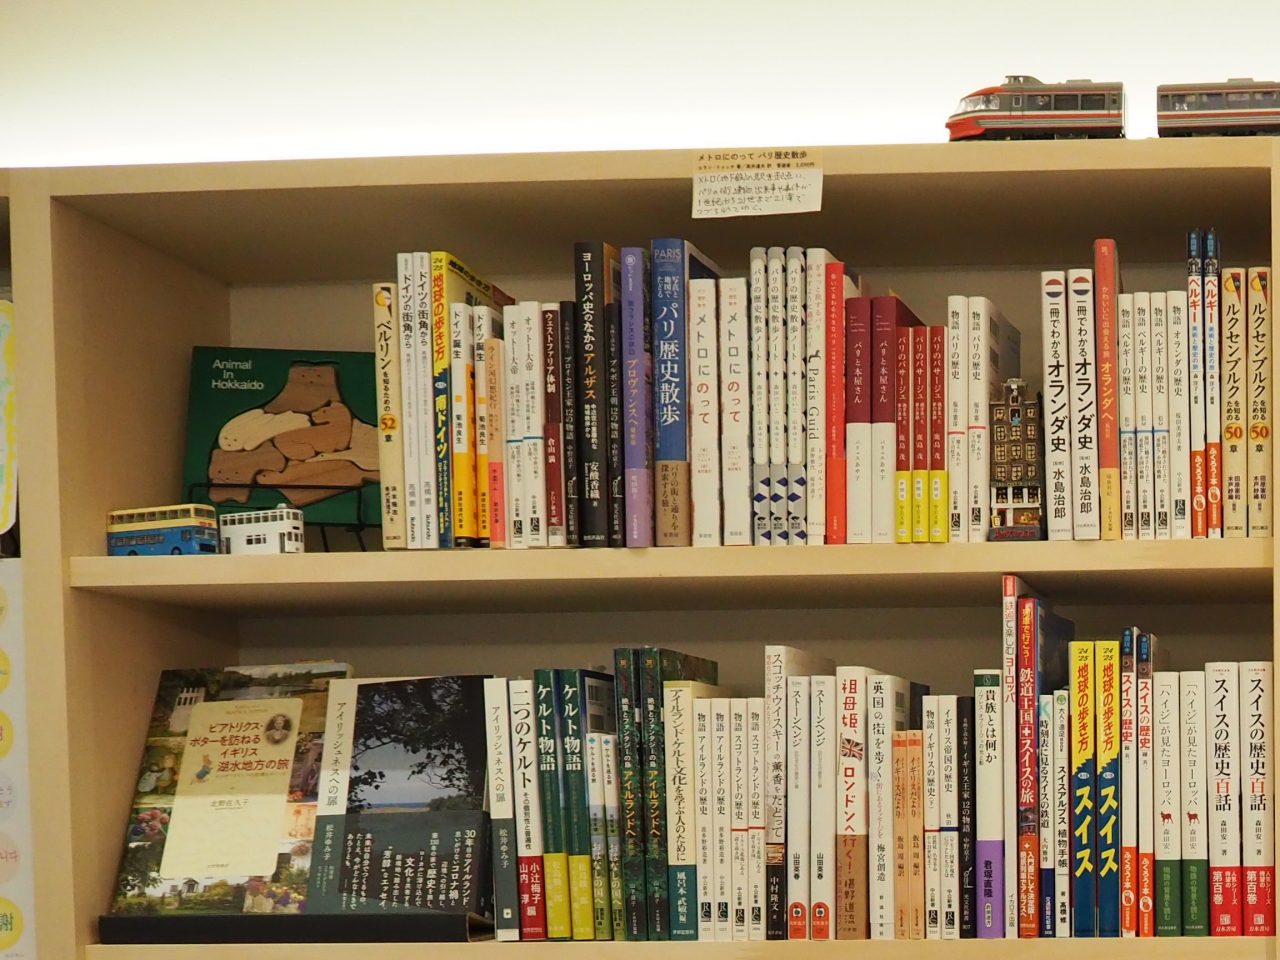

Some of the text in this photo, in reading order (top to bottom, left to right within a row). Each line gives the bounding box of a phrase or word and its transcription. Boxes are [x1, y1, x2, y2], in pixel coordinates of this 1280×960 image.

[698, 151, 807, 161] メトロにのって パリ歴史散歩
[655, 249, 681, 260] PARIS
[432, 274, 444, 363] 地球の歩き方
[453, 311, 461, 359] ドイツ誕生
[1188, 278, 1201, 323] ベルギー
[211, 380, 264, 390] Hokkaido
[213, 359, 251, 369] Animal
[223, 370, 233, 378] In
[657, 306, 681, 425] パリ歴史散歩
[696, 312, 710, 425] メトロにのって
[853, 340, 862, 404] パリと本屋さん
[1048, 301, 1066, 453] 一冊でわかるオランダ史
[1074, 299, 1093, 451] 一冊でわかるオランダ史
[1121, 309, 1132, 396] 物語 ベルギーの歴史
[1172, 305, 1183, 397] 物語 オランダの歴史
[1052, 468, 1066, 519] 水島治郎
[513, 690, 532, 790] 二つのケルト
[537, 684, 556, 771] ケルト物語
[792, 690, 803, 748] ストーンヘンジ
[872, 681, 885, 780] 英国の街を歩く
[943, 709, 953, 792] イギリス帝国の歴史
[984, 690, 997, 764] 貴族とは何か
[1077, 663, 1088, 754] 地球の歩き方
[1122, 674, 1132, 743] スイスの歴史
[1214, 679, 1232, 812] スイスの歴史百話
[217, 759, 290, 772] 湖水地方の旅
[220, 748, 258, 757] イギリス
[670, 689, 687, 862] アイルランド・ケルト文化を学ぶ人のために
[697, 712, 708, 816] 物語 アイルランドの歴史
[734, 712, 743, 820] 物語 スコットランドの歴史
[1074, 785, 1092, 878] スイス
[1099, 785, 1118, 878] スイス
[1212, 870, 1223, 905] 第百巻
